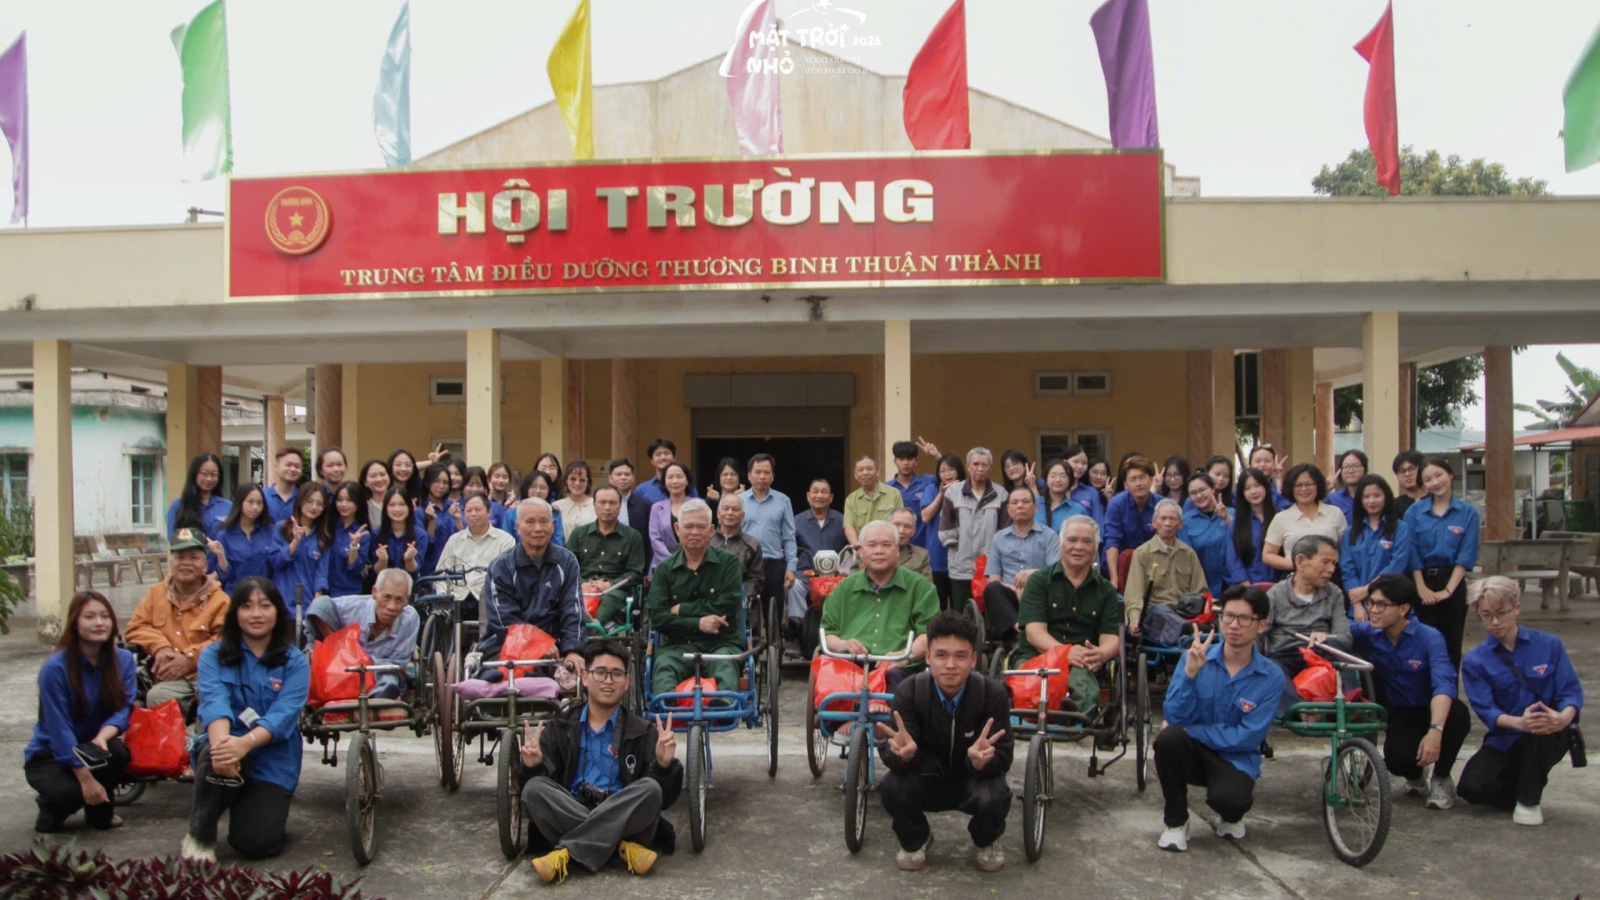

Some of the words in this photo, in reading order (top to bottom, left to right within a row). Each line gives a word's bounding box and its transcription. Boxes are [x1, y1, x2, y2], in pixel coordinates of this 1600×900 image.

[437, 177, 568, 244] HỘI
[595, 166, 935, 229] TRƯỜNG
[339, 266, 425, 287] TRUNG
[431, 261, 485, 285] TÂM
[492, 255, 552, 282] ĐIỀU
[563, 257, 649, 281] DƯỠNG
[656, 255, 763, 277] THƯƠNG
[770, 257, 838, 276] BINH
[845, 251, 938, 277] THUẬN
[945, 248, 1042, 273] THÀNH
